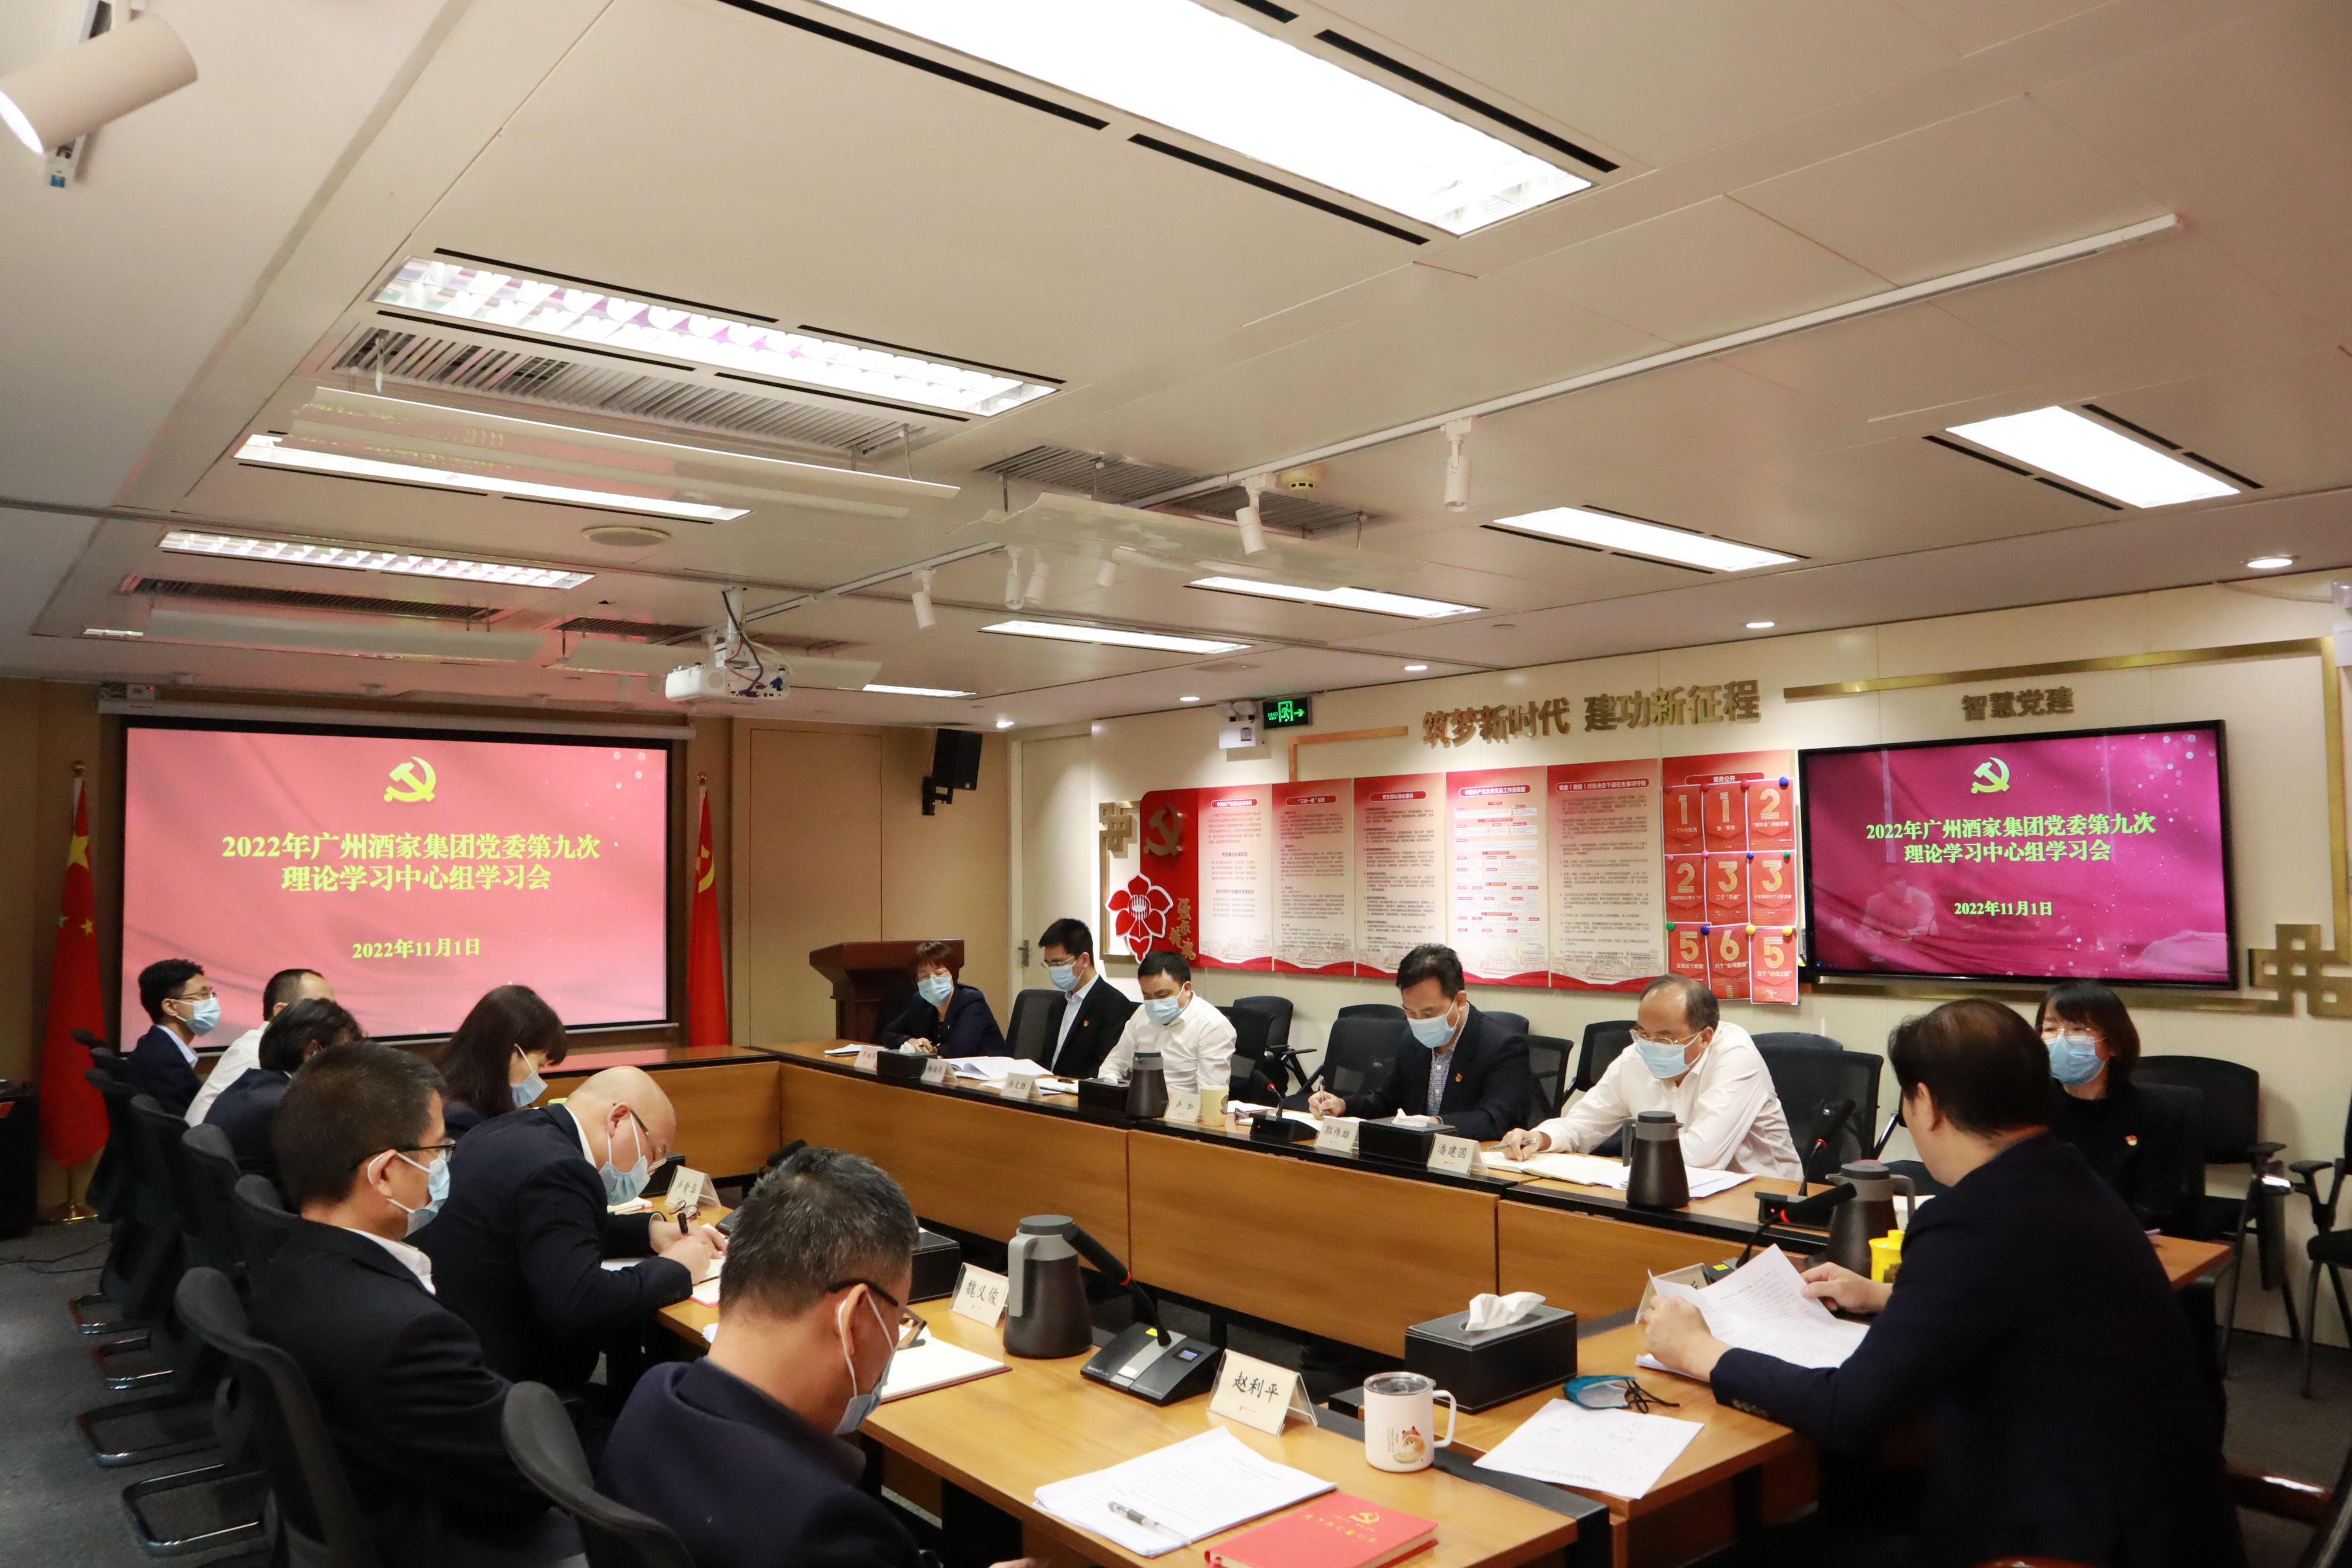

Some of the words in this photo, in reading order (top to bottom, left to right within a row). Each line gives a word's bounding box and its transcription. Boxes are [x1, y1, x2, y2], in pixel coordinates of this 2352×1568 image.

[1422, 697, 1570, 747] 筑梦新时代
[1584, 680, 1761, 732] 建功新征程
[1962, 686, 2075, 721] 智慧党建
[1464, 786, 1526, 795] 中国共产党发展党员工作流程图
[1760, 788, 1781, 820] 2
[1679, 795, 1688, 825] 1
[1720, 792, 1730, 822] 1
[1866, 811, 2157, 841] 2022年广州酒家集团党委第九次
[221, 832, 601, 861] 2022年广州酒家集团党委第九次
[1904, 839, 2112, 864] 理论学习中心组学习会
[282, 864, 552, 892] 理论学习中心组学习会
[1677, 863, 1695, 893] 2
[1718, 861, 1737, 892] 3
[1762, 860, 1782, 891] 3
[1954, 900, 2052, 916] 2022年11月1日
[352, 937, 481, 959] 2022年11月1日
[1680, 931, 1699, 961] 5
[1720, 930, 1740, 961] 6
[1763, 937, 1784, 969] 5
[1324, 1124, 1350, 1140] 郭伟雄
[1438, 1144, 1467, 1159] 潘建国
[965, 1280, 998, 1305] 魏义俊
[1232, 1371, 1279, 1404] 赵利平
